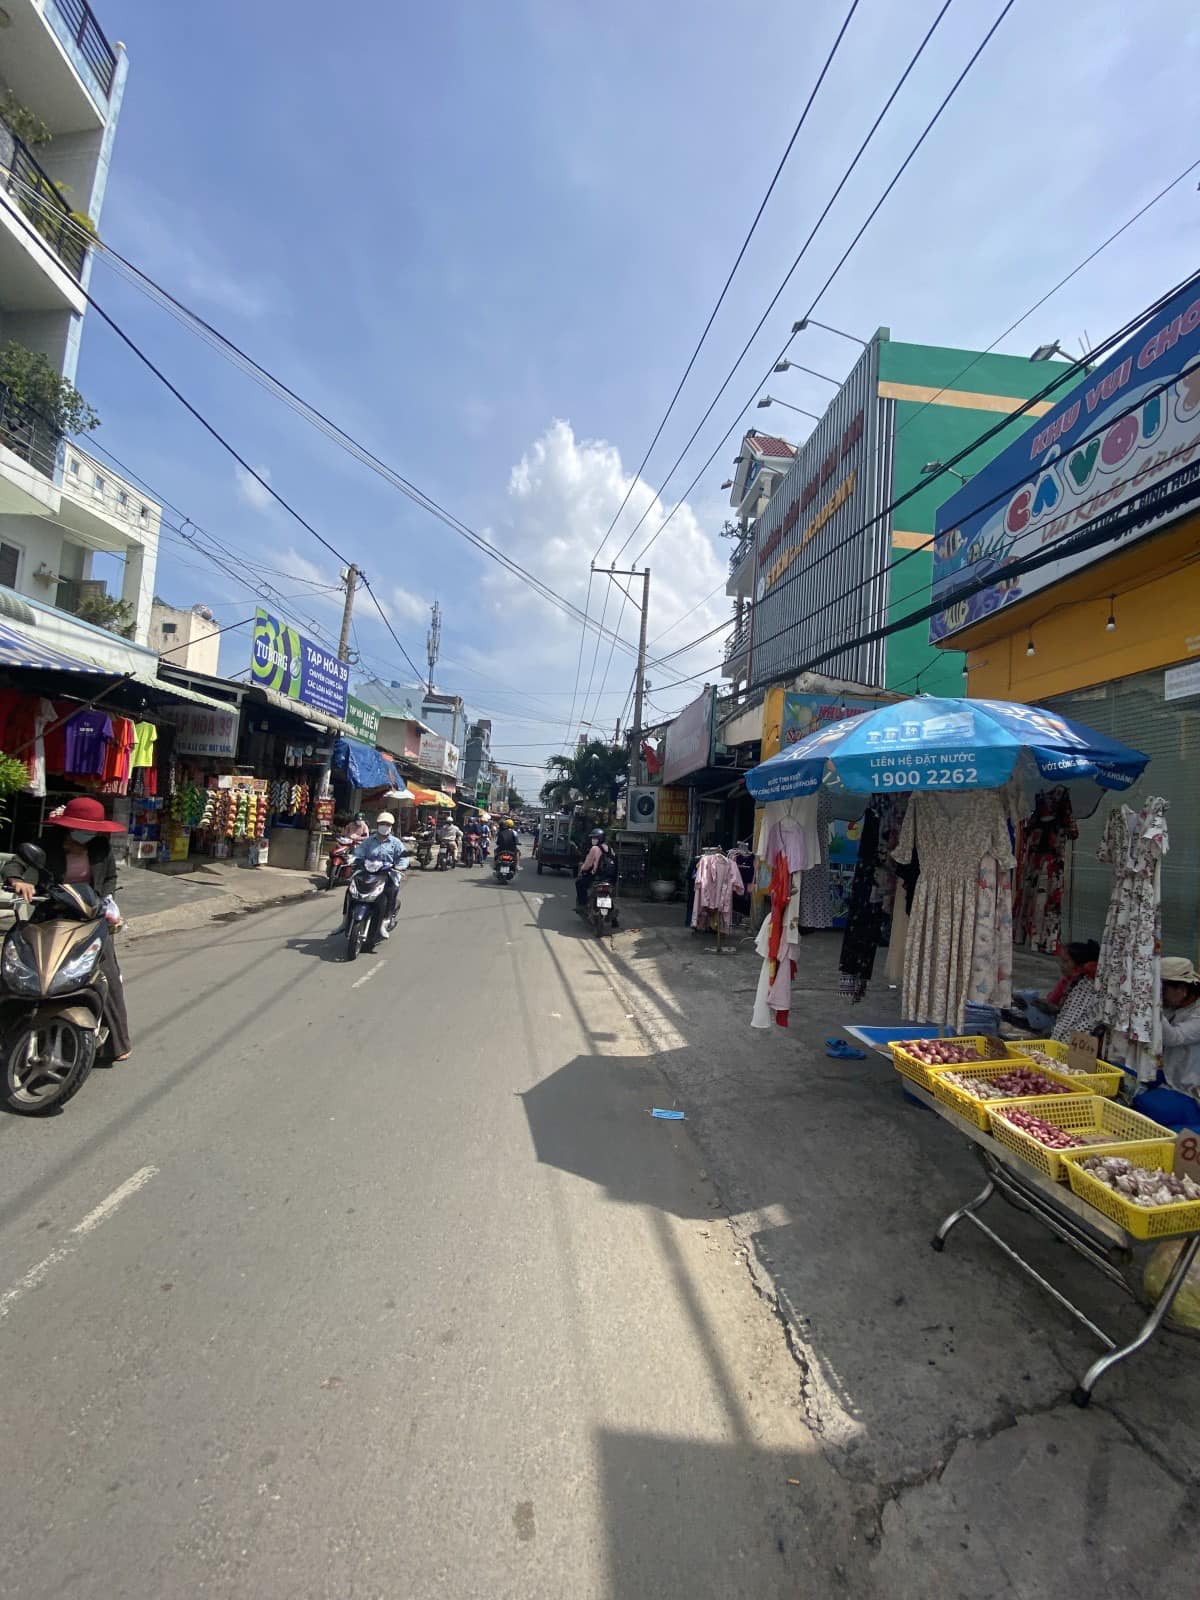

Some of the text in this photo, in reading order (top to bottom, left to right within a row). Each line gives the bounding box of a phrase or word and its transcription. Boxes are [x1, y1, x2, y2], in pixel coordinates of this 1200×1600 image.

[1030, 399, 1082, 461] KHU
[1085, 356, 1133, 414] VUI
[256, 640, 289, 672] TUBORG
[306, 647, 348, 682] TẠP HÓA 39
[870, 752, 976, 768] LIÊN HỆ ĐẶT NƯỚC
[871, 768, 978, 787] 1900 2262
